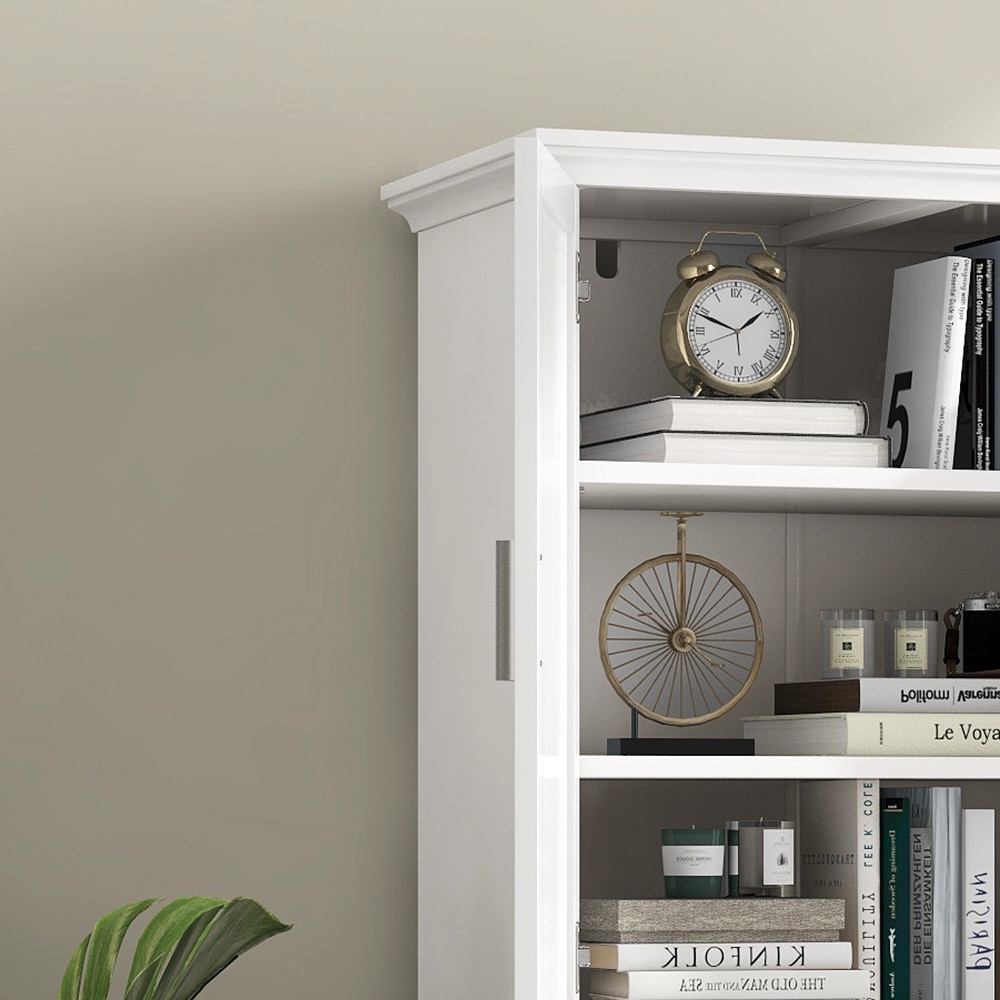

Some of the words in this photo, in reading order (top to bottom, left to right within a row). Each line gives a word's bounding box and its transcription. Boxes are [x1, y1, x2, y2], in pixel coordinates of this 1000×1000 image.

[951, 262, 959, 272] The
[976, 263, 984, 274] The
[976, 274, 984, 299] Essential
[976, 300, 984, 316] Guide
[974, 324, 984, 356] Typography
[887, 370, 914, 469] 5
[934, 723, 954, 741] Le
